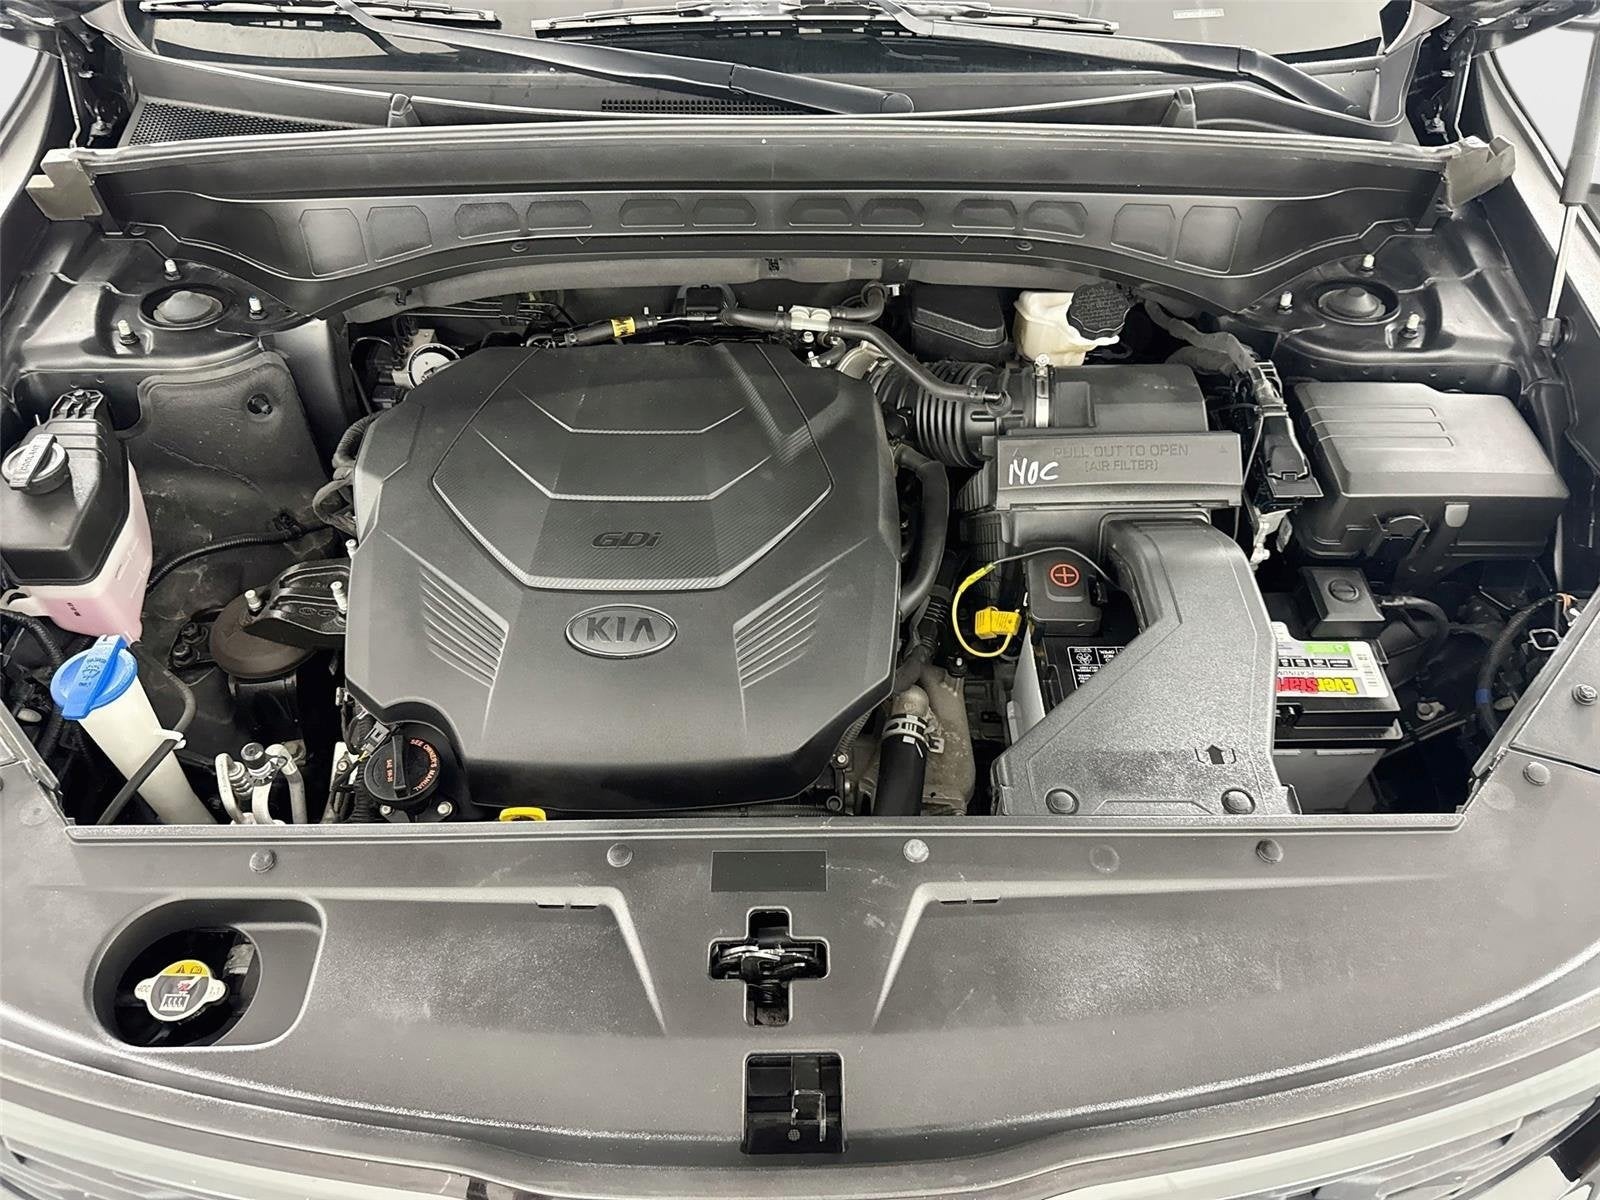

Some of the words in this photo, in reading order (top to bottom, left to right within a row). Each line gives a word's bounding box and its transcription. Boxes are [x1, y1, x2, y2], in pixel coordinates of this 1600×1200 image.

[1094, 445, 1121, 457] OUT
[1128, 445, 1146, 457] TO
[1151, 443, 1189, 456] OPEN
[586, 616, 657, 642] KIA
